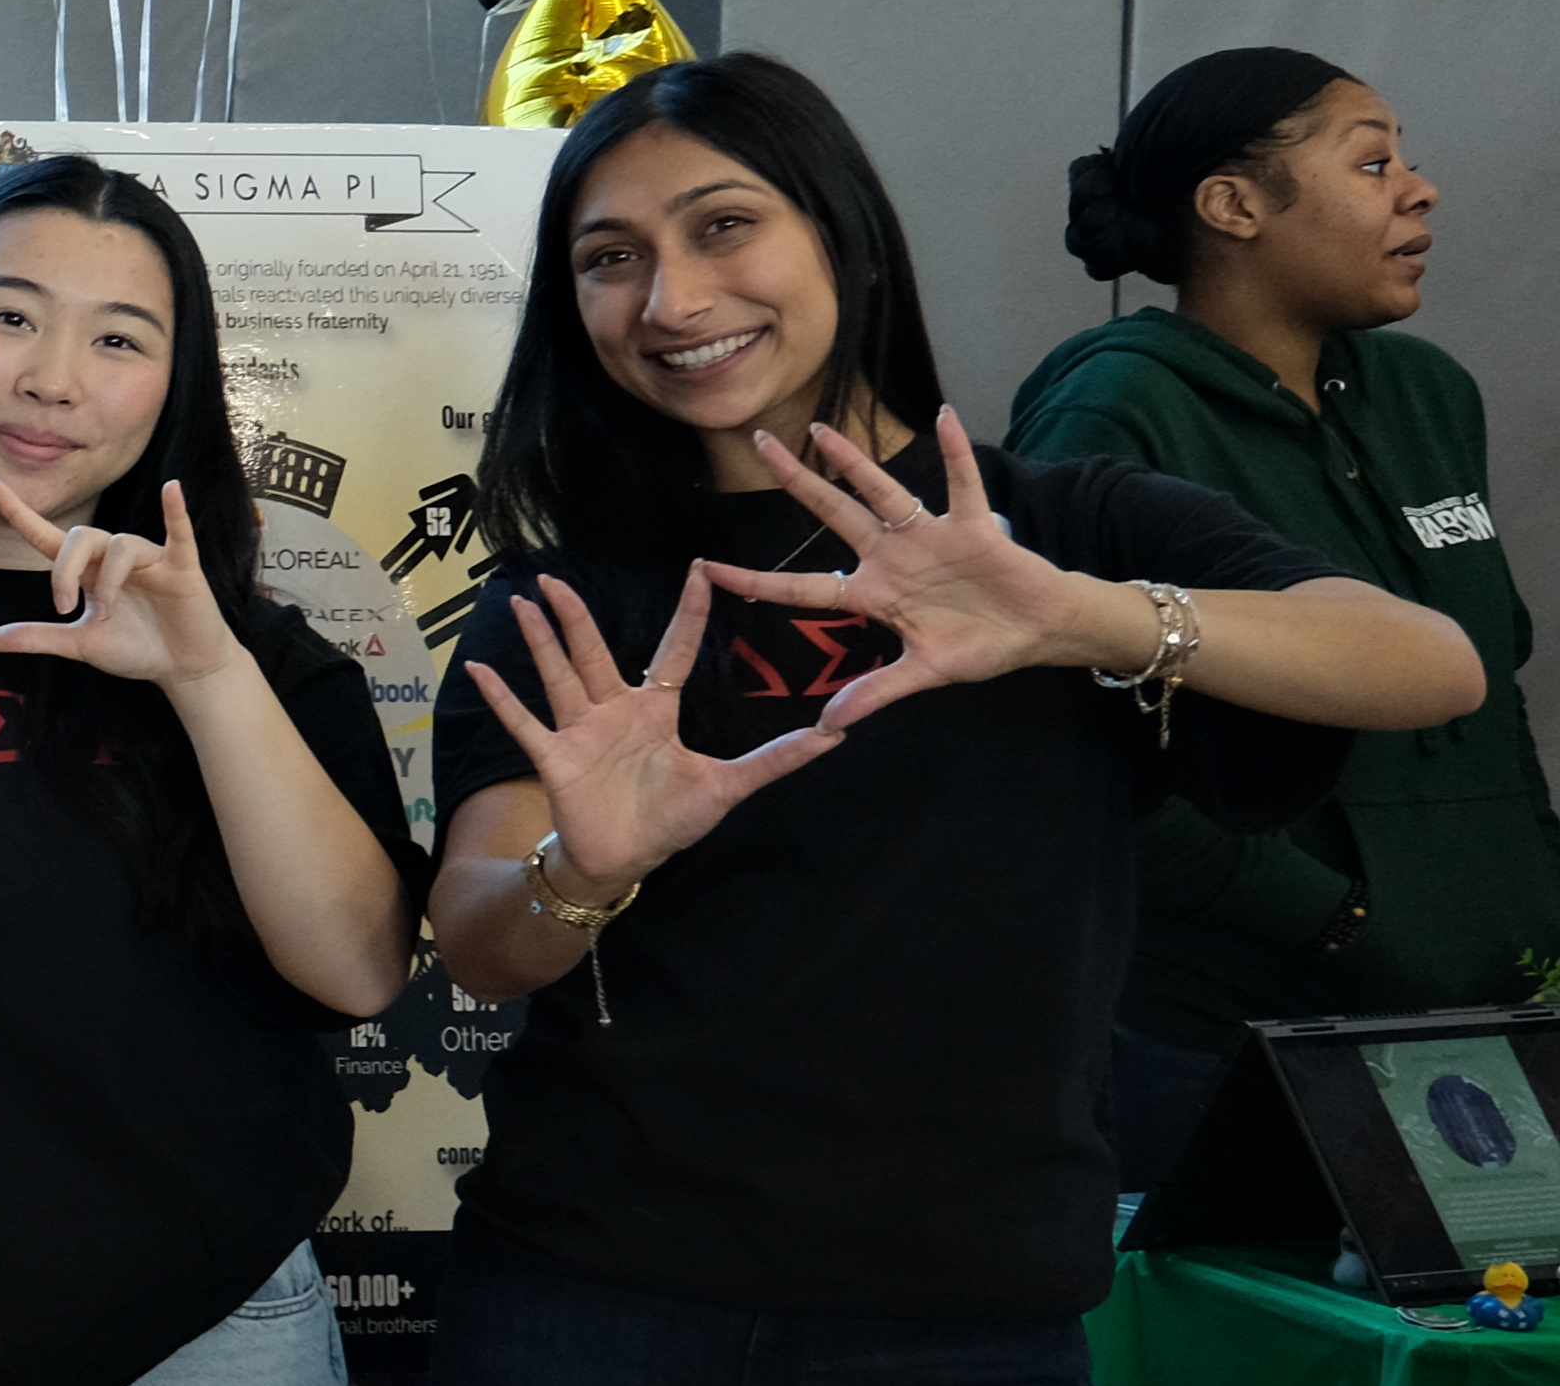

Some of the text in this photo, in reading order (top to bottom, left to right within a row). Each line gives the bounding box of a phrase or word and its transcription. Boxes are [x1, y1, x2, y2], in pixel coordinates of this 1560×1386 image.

[195, 173, 321, 201] SIGMA
[347, 174, 376, 200] PI
[216, 259, 293, 280] originally
[298, 259, 369, 277] founded
[374, 264, 397, 277] on
[400, 259, 438, 280] April
[250, 286, 346, 303] reactivated
[349, 286, 378, 303] this
[383, 286, 456, 308] uniquely
[461, 286, 524, 303] diverse
[226, 312, 303, 329] business
[442, 405, 475, 429] Our
[426, 508, 452, 536] 52
[302, 603, 396, 622] PACEX
[350, 1022, 387, 1048] 12%
[441, 1025, 513, 1052] Other
[335, 1056, 404, 1074] Finance
[367, 1315, 437, 1334] brothers
